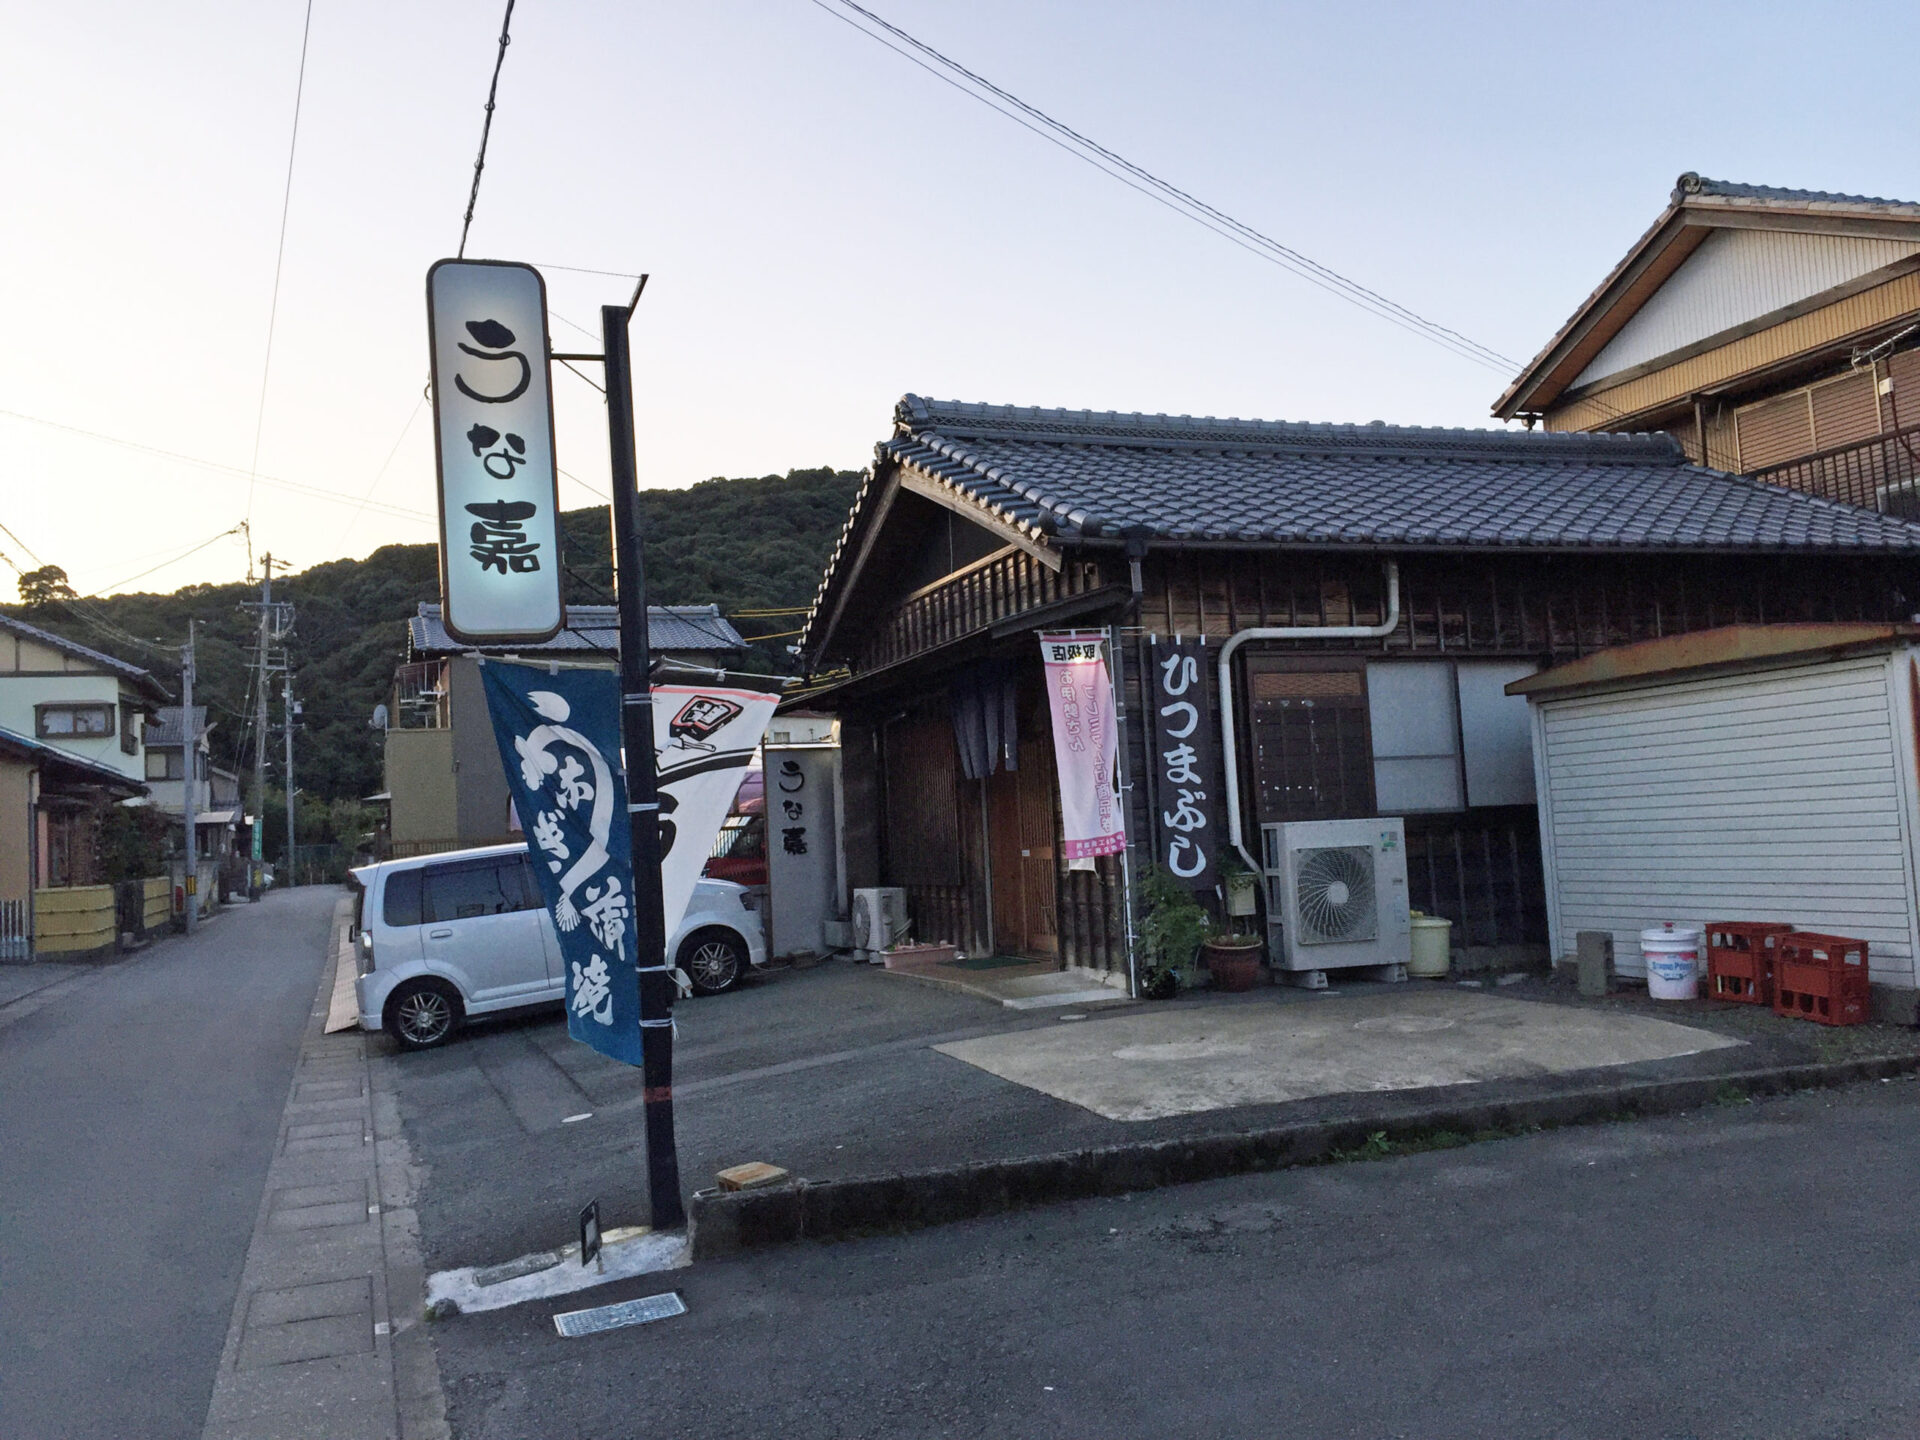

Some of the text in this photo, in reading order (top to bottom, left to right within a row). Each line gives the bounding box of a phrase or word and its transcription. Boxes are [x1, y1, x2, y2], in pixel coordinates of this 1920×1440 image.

[454, 318, 541, 575] うな嘉
[1160, 653, 1207, 878] ひつまぶし
